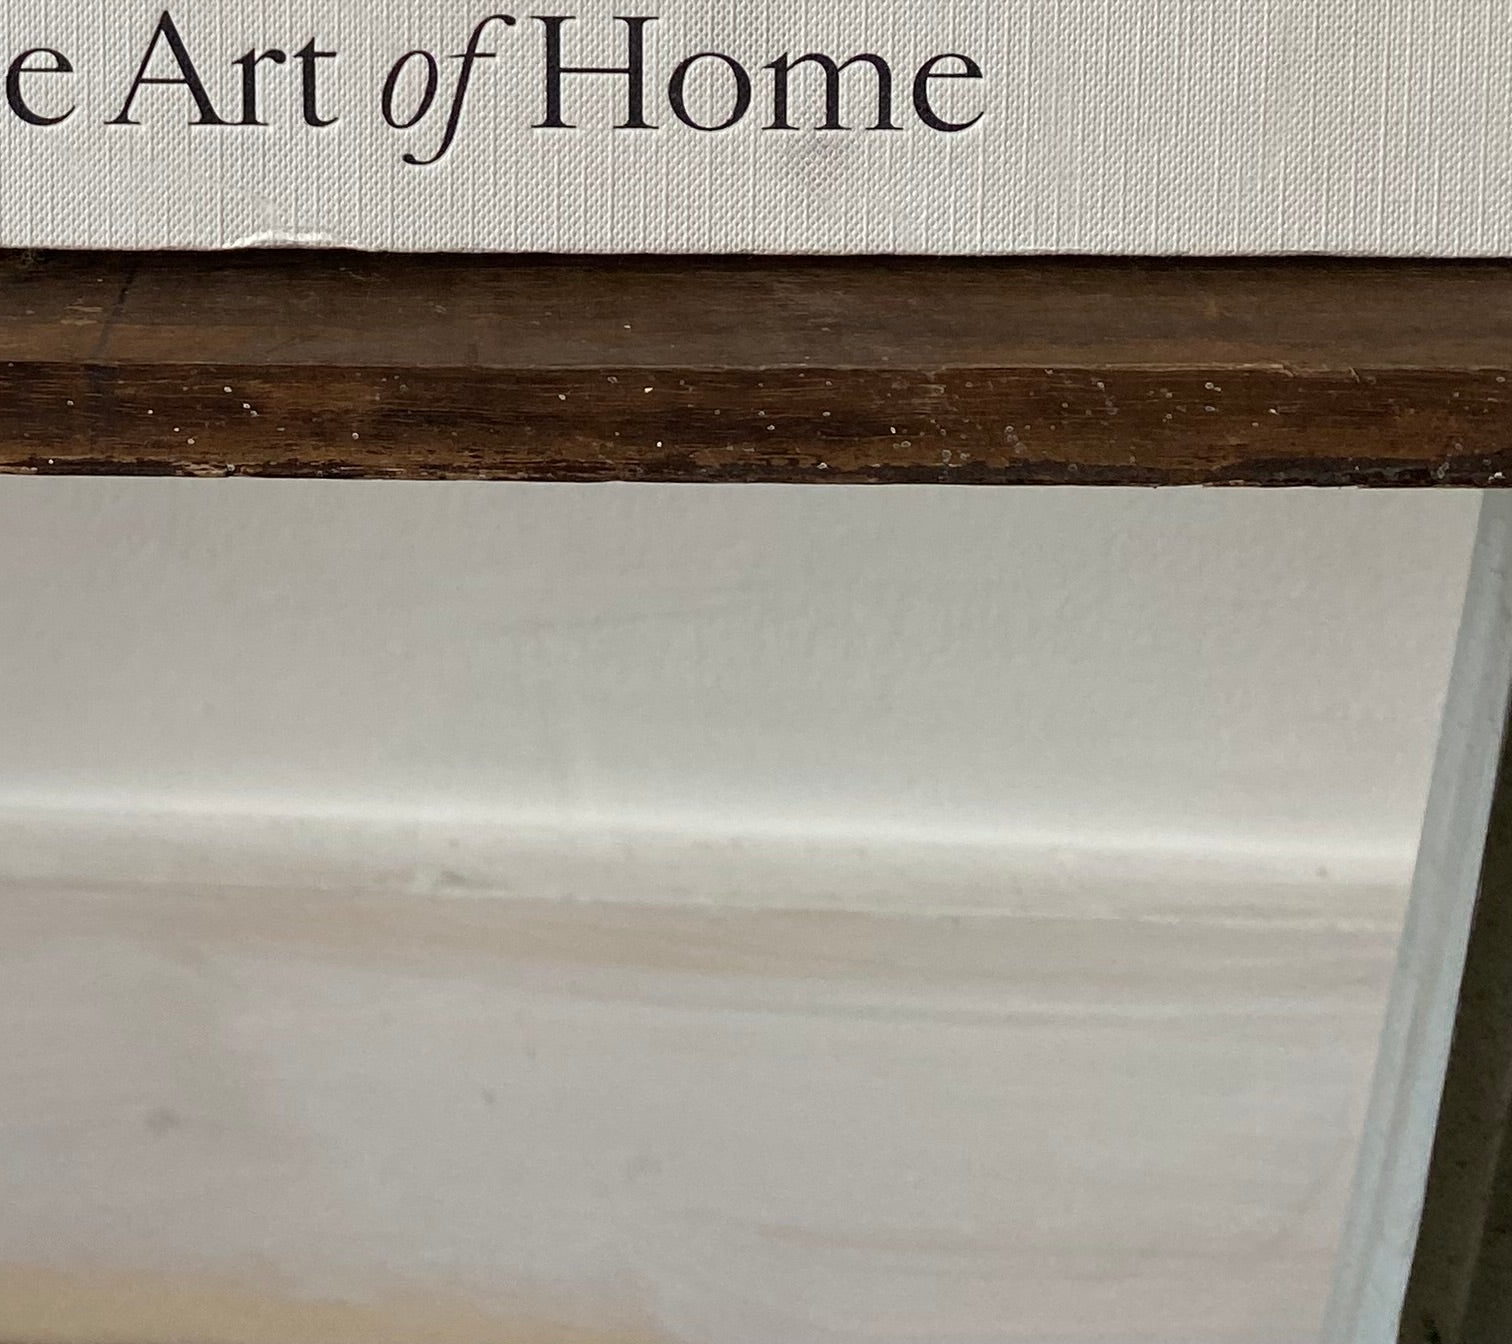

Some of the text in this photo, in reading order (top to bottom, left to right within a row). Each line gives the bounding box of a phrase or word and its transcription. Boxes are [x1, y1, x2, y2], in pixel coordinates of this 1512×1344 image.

[104, 9, 339, 127] Art
[380, 14, 516, 166] of
[529, 15, 986, 134] Home
